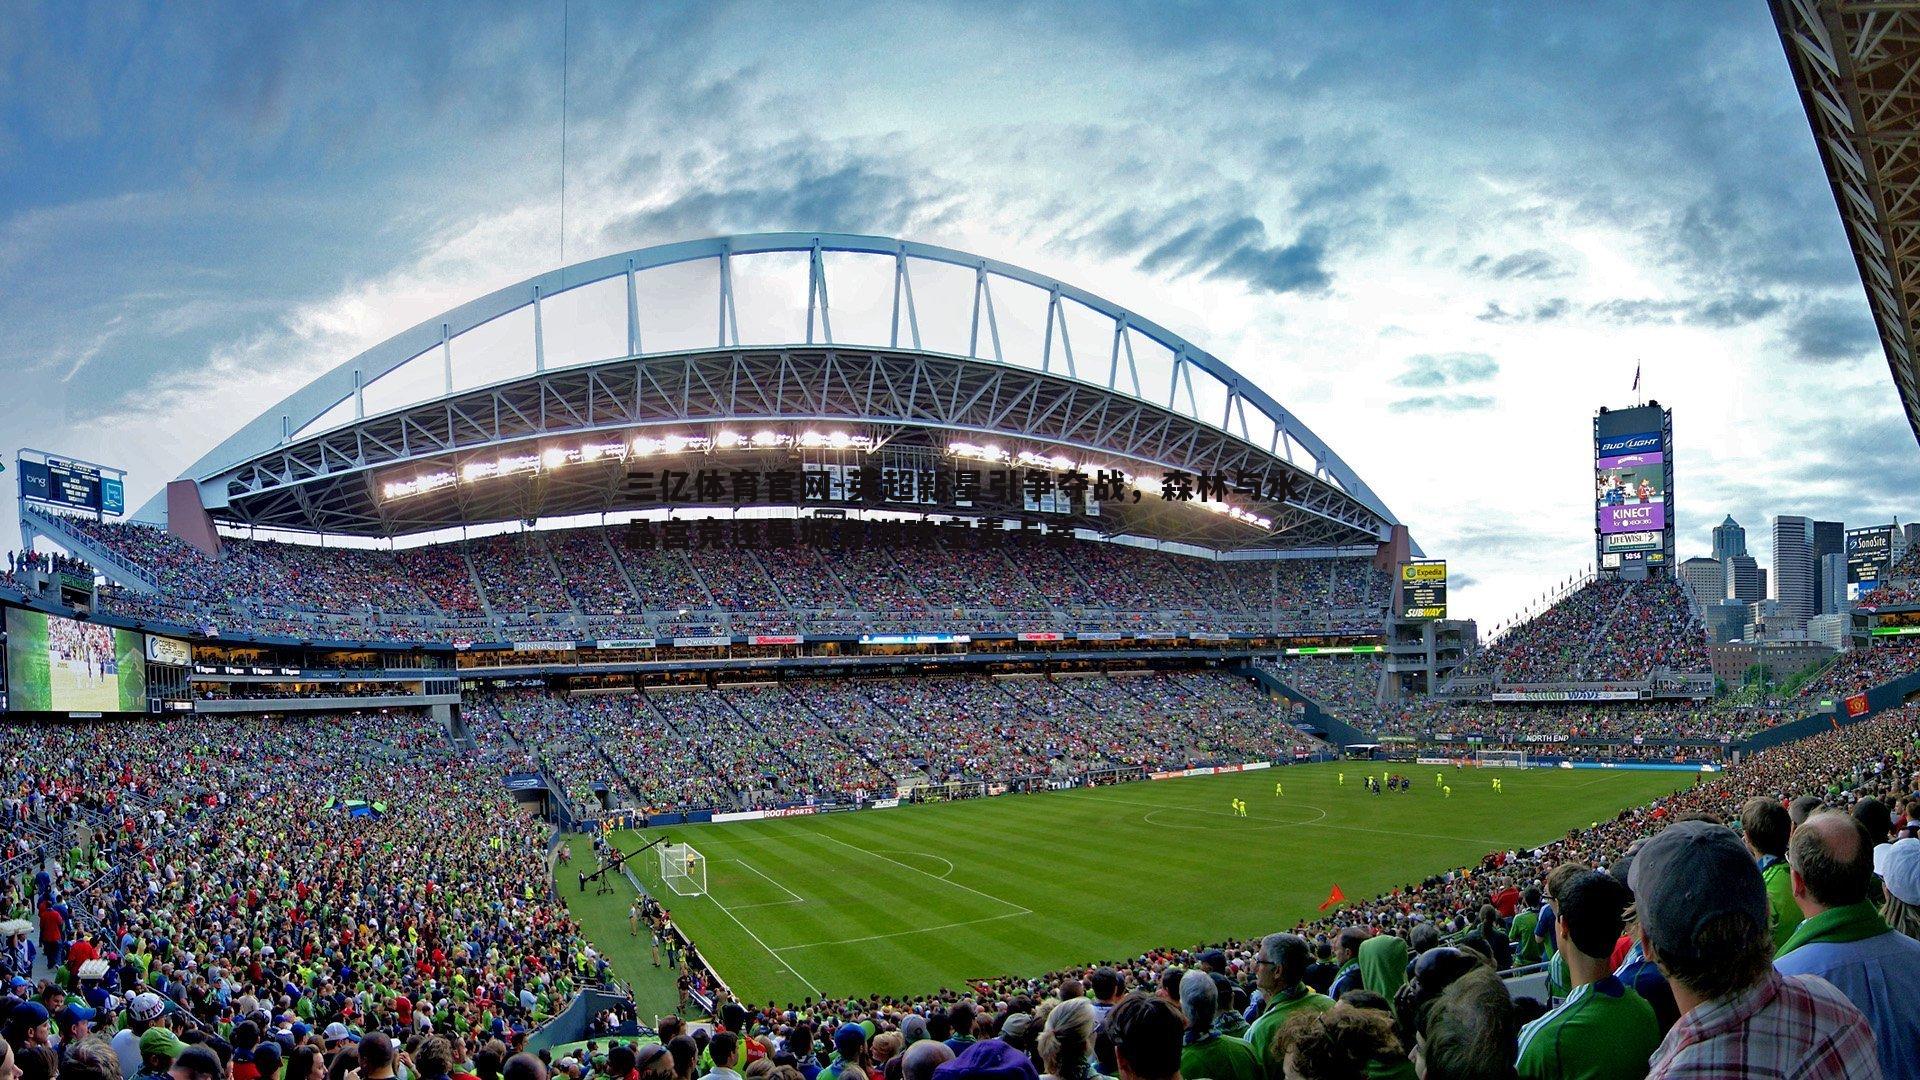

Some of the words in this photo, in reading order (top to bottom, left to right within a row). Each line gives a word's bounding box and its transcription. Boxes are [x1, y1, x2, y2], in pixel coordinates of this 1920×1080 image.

[1628, 439, 1658, 447] LIGHT
[26, 474, 46, 487] bing
[1613, 507, 1652, 519] KINECT
[1858, 535, 1887, 548] SonoSite
[1417, 569, 1442, 577] Expedia
[1405, 608, 1445, 617] SUBWAY
[1553, 734, 1569, 742] END
[764, 809, 786, 818] ROOT
[786, 807, 814, 816] SPORTS
